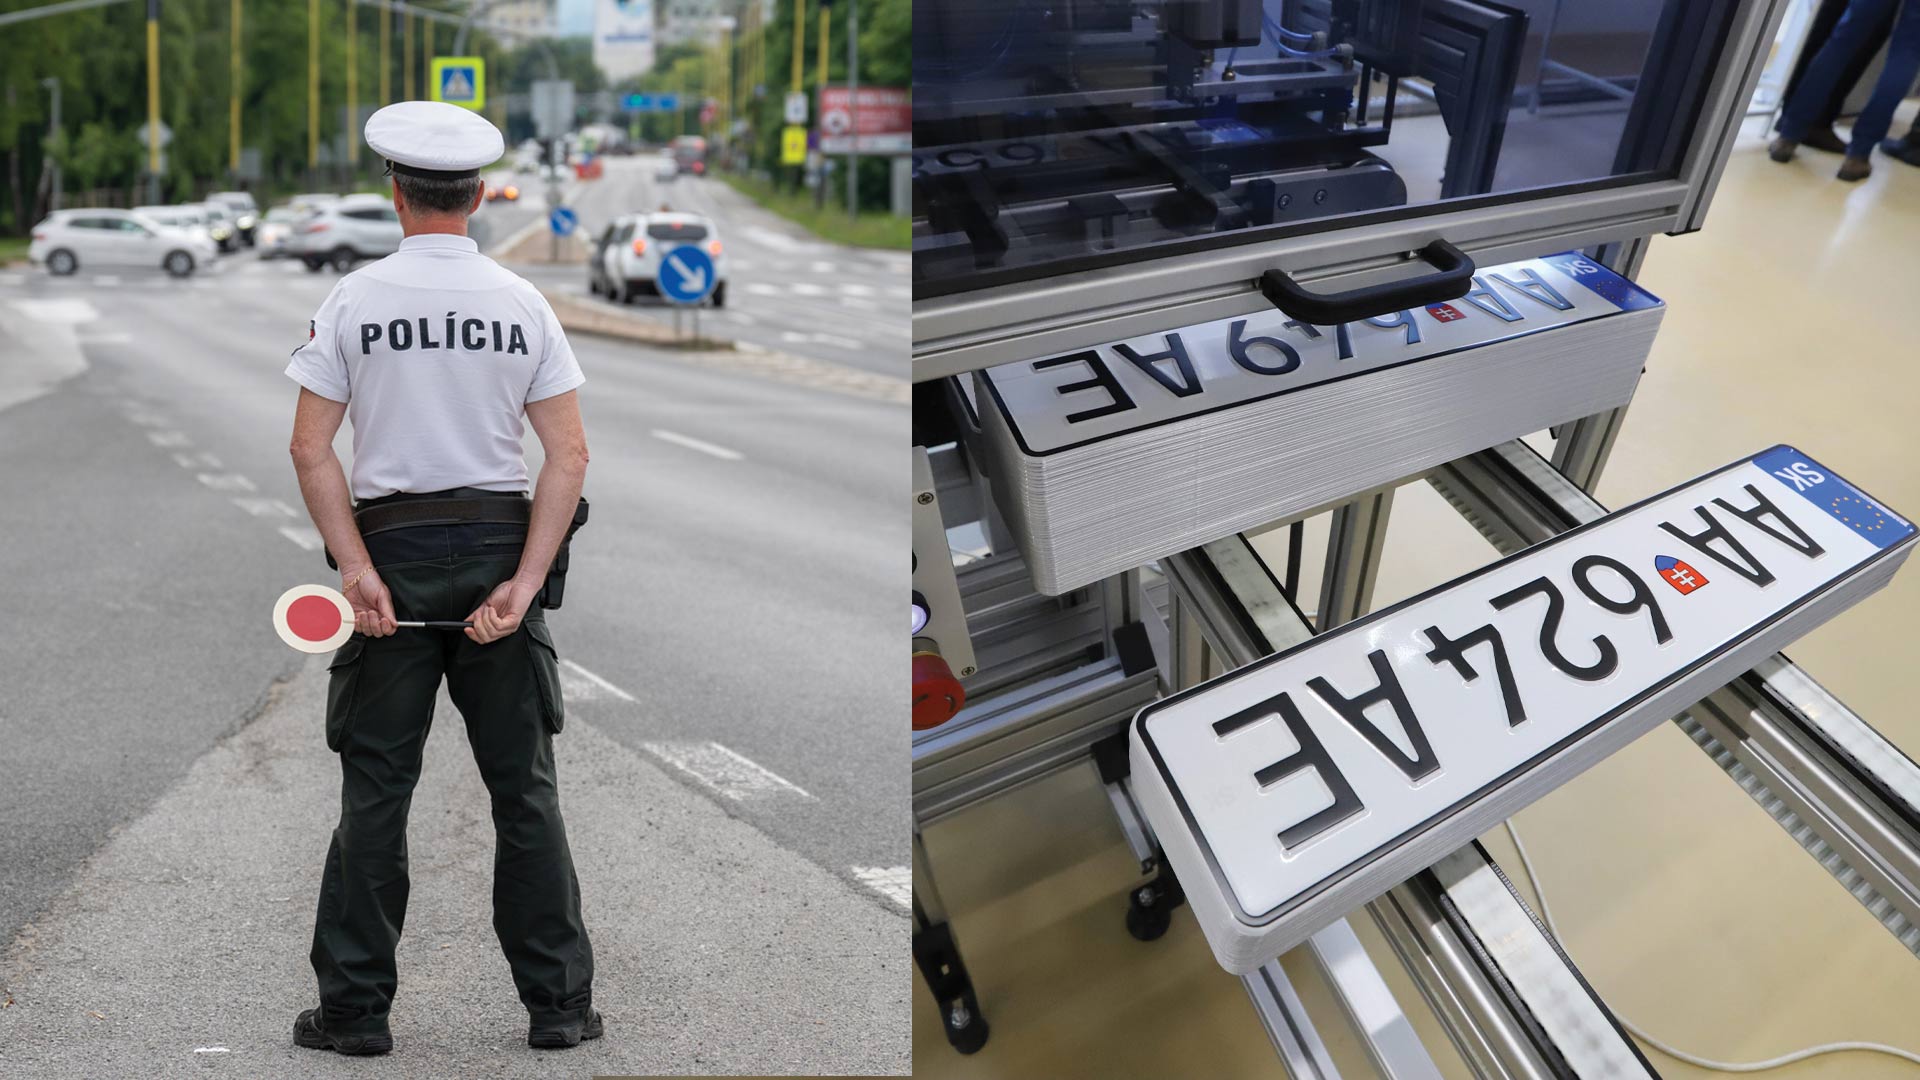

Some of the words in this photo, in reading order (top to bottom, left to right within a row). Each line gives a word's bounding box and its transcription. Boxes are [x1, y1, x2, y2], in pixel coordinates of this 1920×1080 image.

[912, 141, 1045, 180] 65
[1555, 260, 1599, 277] SK
[1460, 267, 1576, 322] AA
[361, 311, 529, 356] POLÍCIA
[1773, 462, 1826, 492] SK
[1658, 483, 1826, 588] AA
